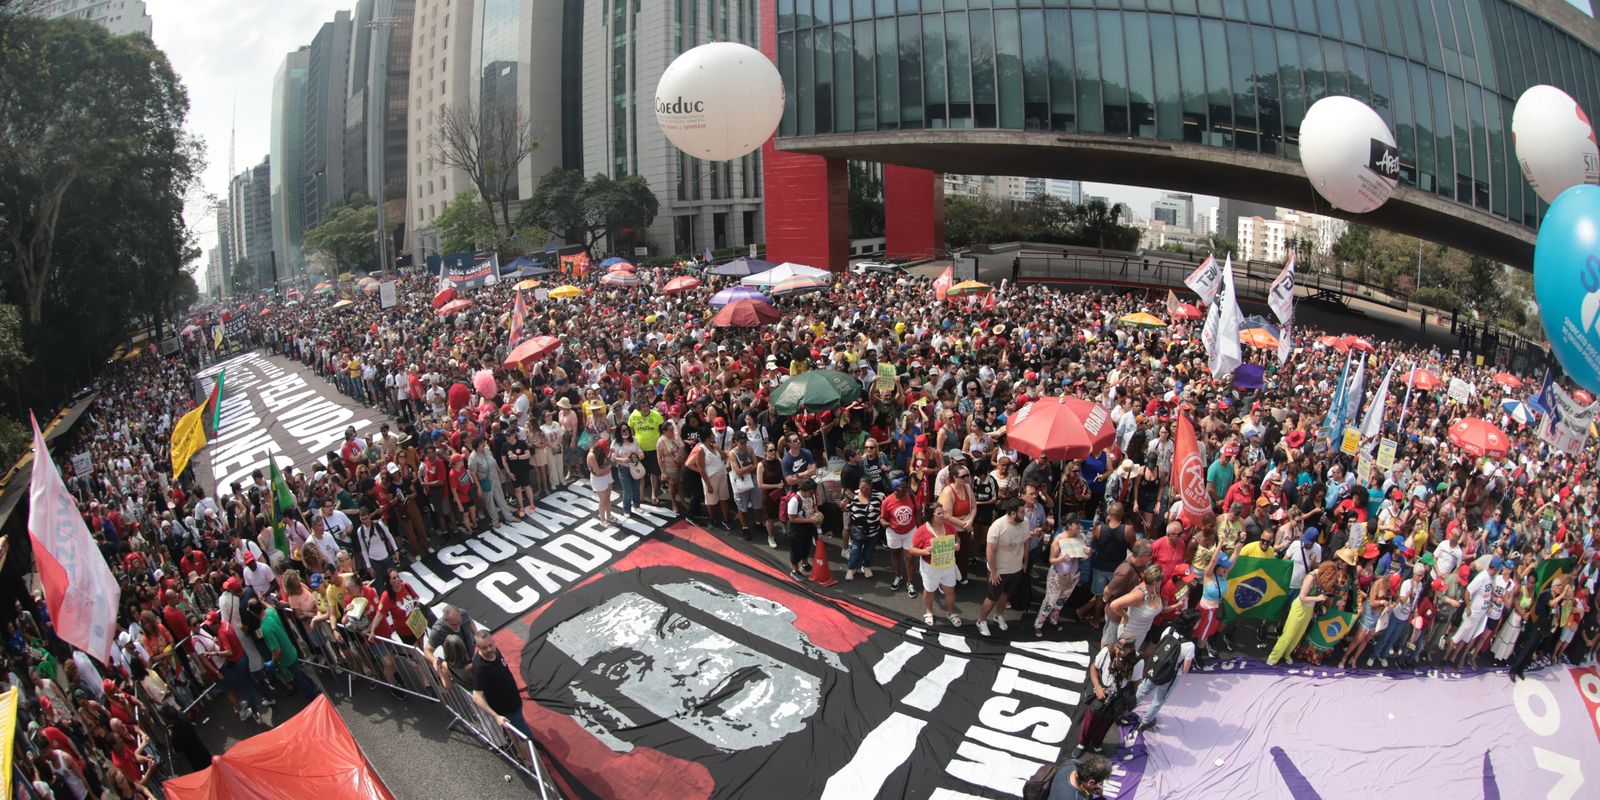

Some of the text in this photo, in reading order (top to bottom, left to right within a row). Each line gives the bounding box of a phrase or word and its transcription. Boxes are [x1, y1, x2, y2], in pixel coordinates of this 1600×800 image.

[256, 371, 316, 413] PELA
[277, 390, 372, 454] VIDA
[210, 428, 306, 500] NEG
[929, 640, 1090, 800] NISTIA
